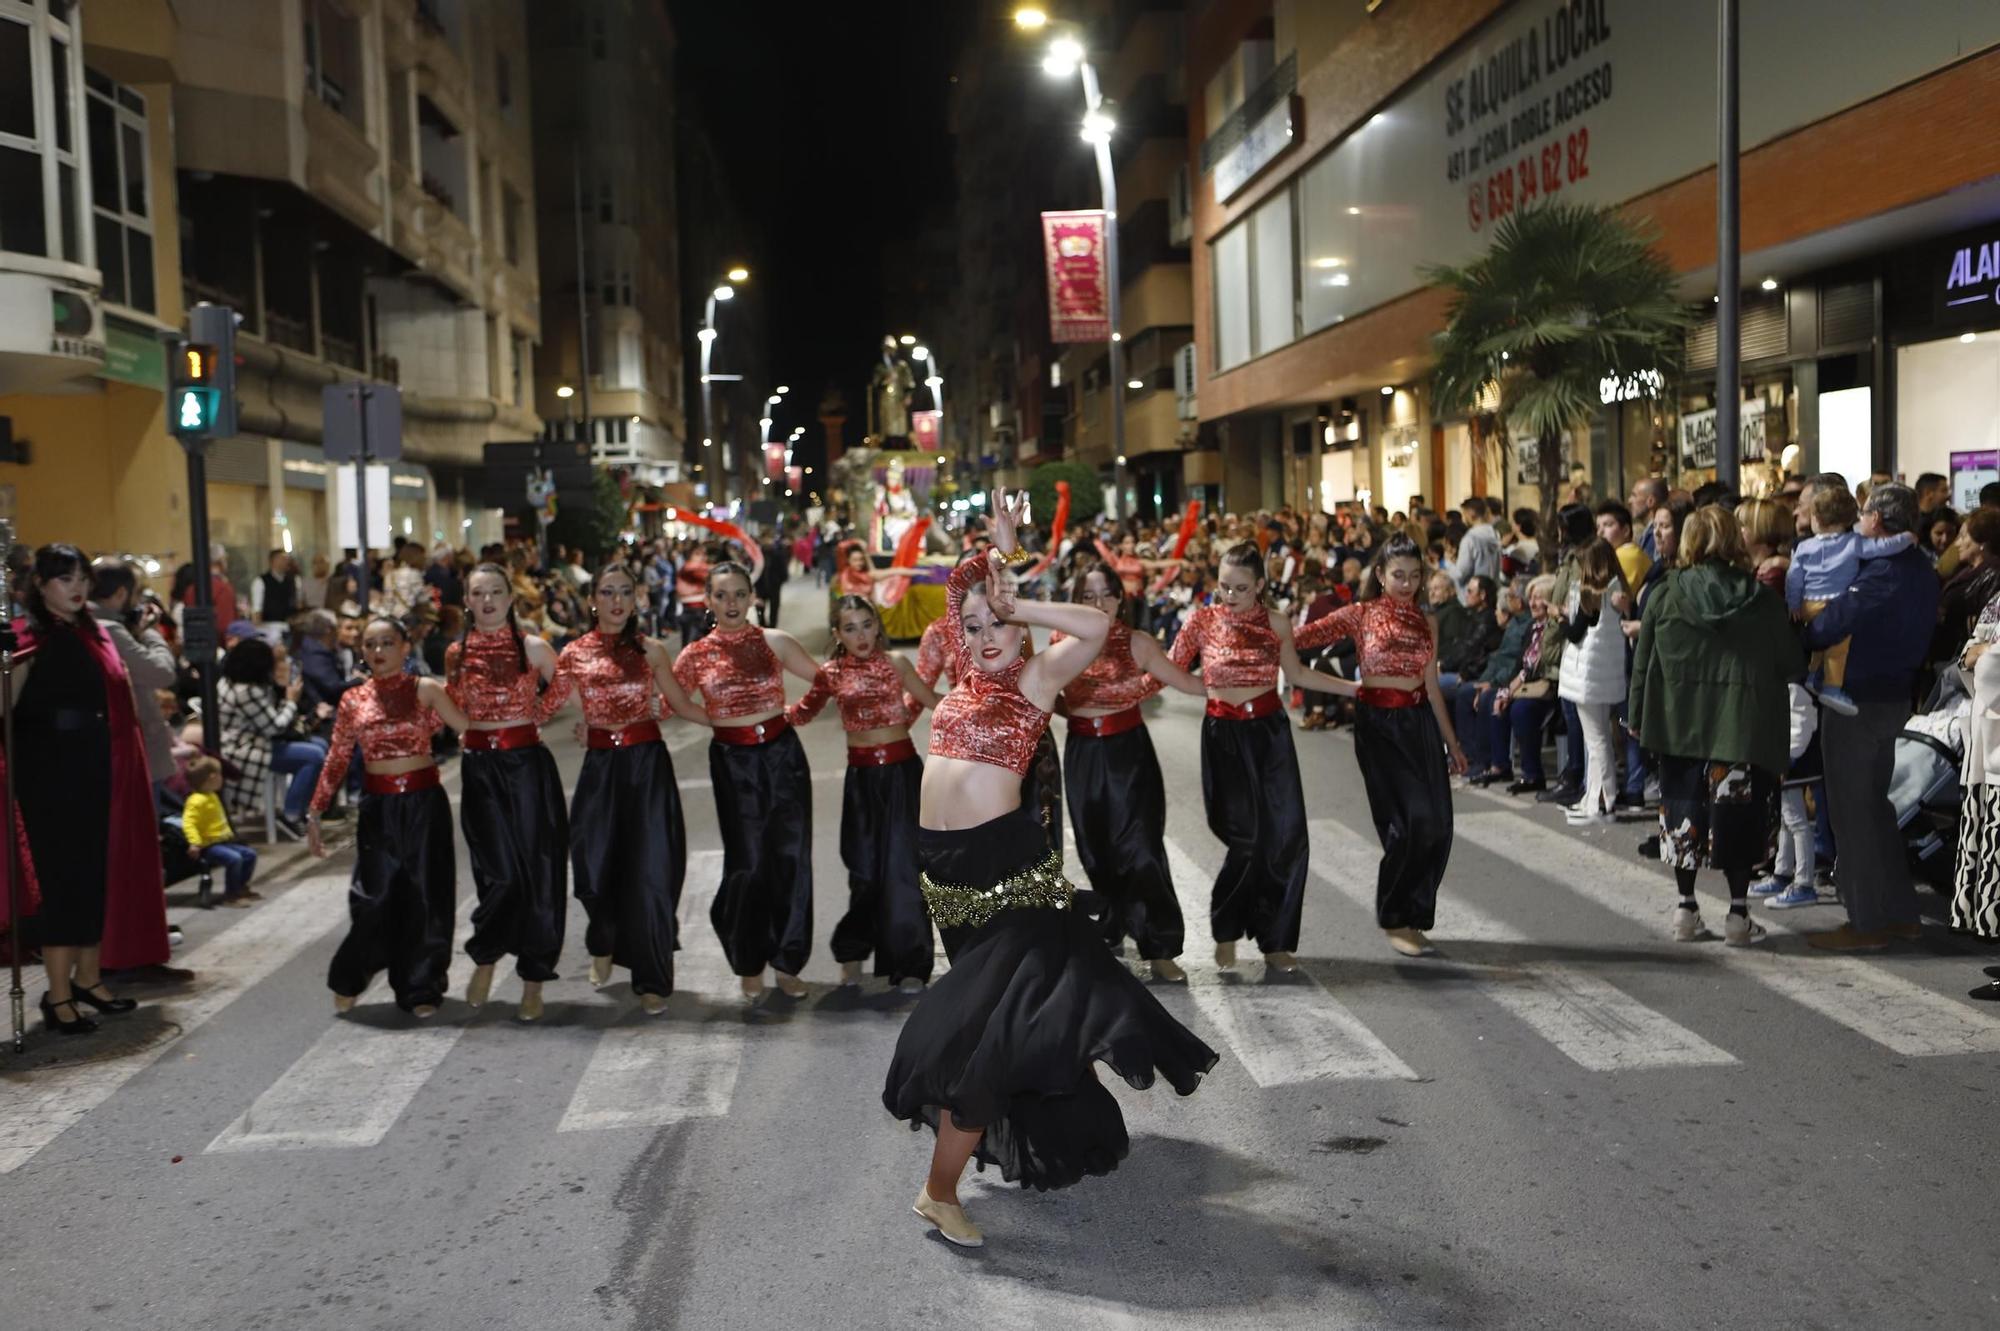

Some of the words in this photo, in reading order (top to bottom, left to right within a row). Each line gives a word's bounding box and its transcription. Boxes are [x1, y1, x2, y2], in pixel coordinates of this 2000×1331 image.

[1446, 78, 1464, 138] SE
[1469, 26, 1540, 125] ALQUILA
[1546, 0, 1611, 75] LOCAL
[1484, 122, 1508, 165] CON
[1511, 97, 1552, 150] DOBLE
[1554, 61, 1612, 127] ACCESO
[1488, 165, 1514, 222] 639
[1518, 154, 1538, 205] 34
[1542, 140, 1562, 193] 62
[1567, 126, 1588, 184] 82
[1695, 438, 1717, 464] FRID
[1741, 417, 1764, 460] 0%
